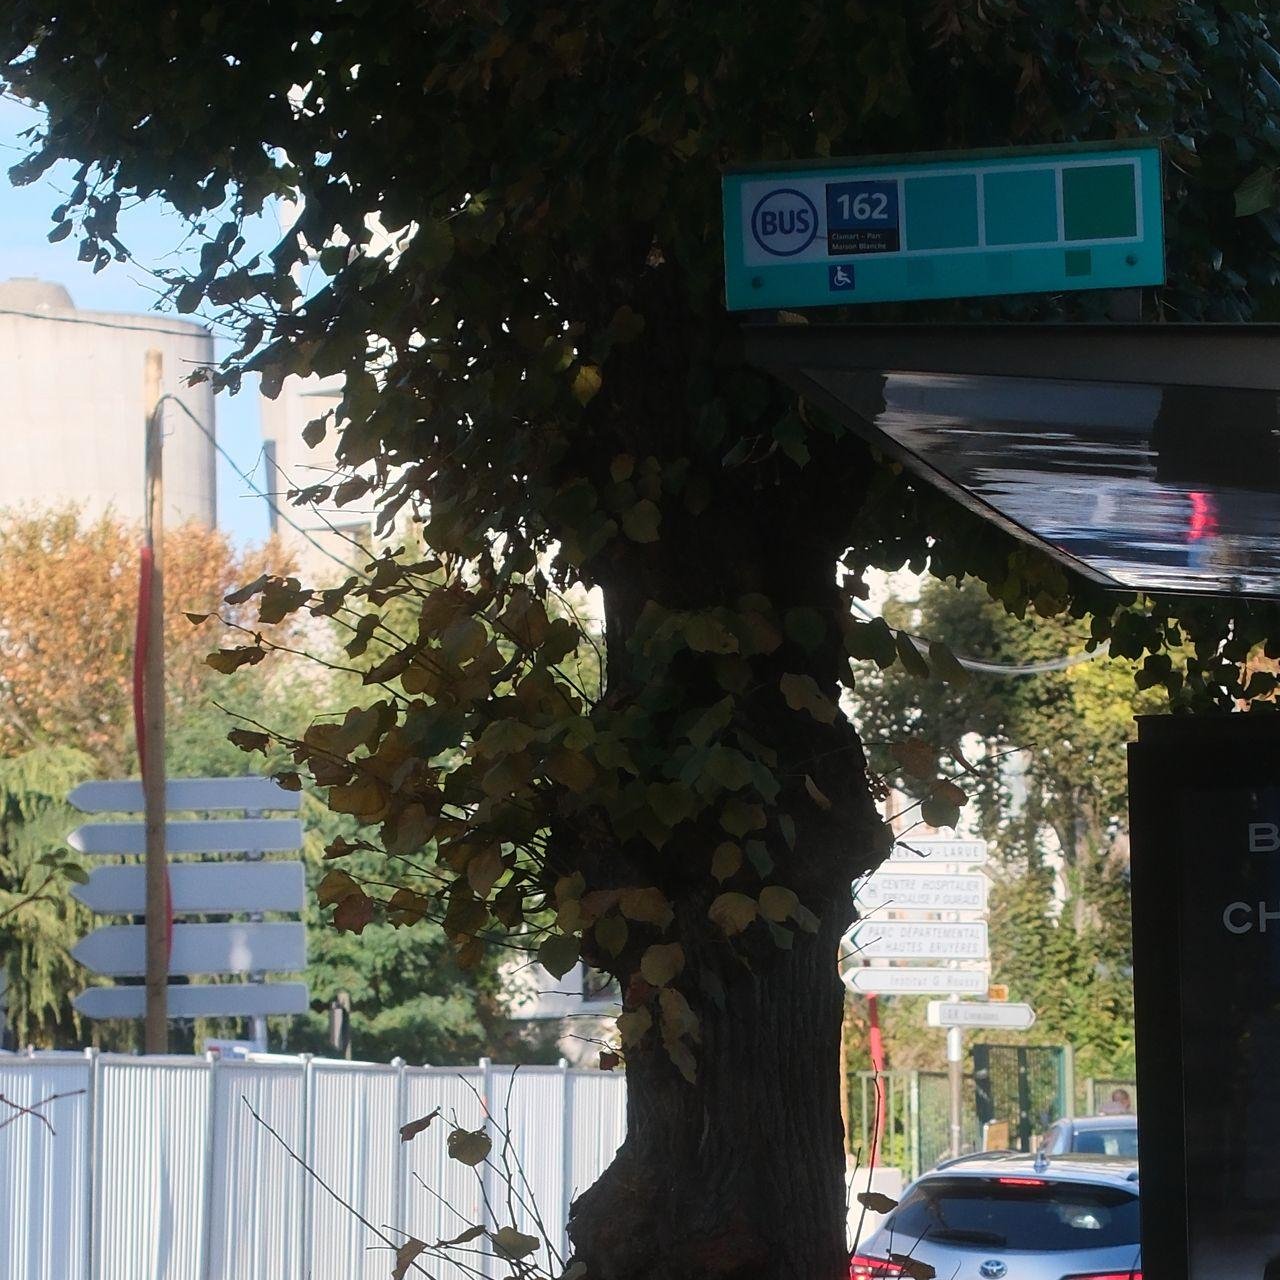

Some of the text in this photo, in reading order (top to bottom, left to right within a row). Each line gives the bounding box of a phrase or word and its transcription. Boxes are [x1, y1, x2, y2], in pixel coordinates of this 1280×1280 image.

[836, 192, 889, 220] 162
[761, 208, 810, 237] BUS
[831, 232, 859, 240] Clamart
[831, 241, 887, 250] Maison Blanche
[882, 879, 916, 890] CENTRE
[868, 926, 895, 938] PARC
[886, 941, 923, 953] HAUTES
